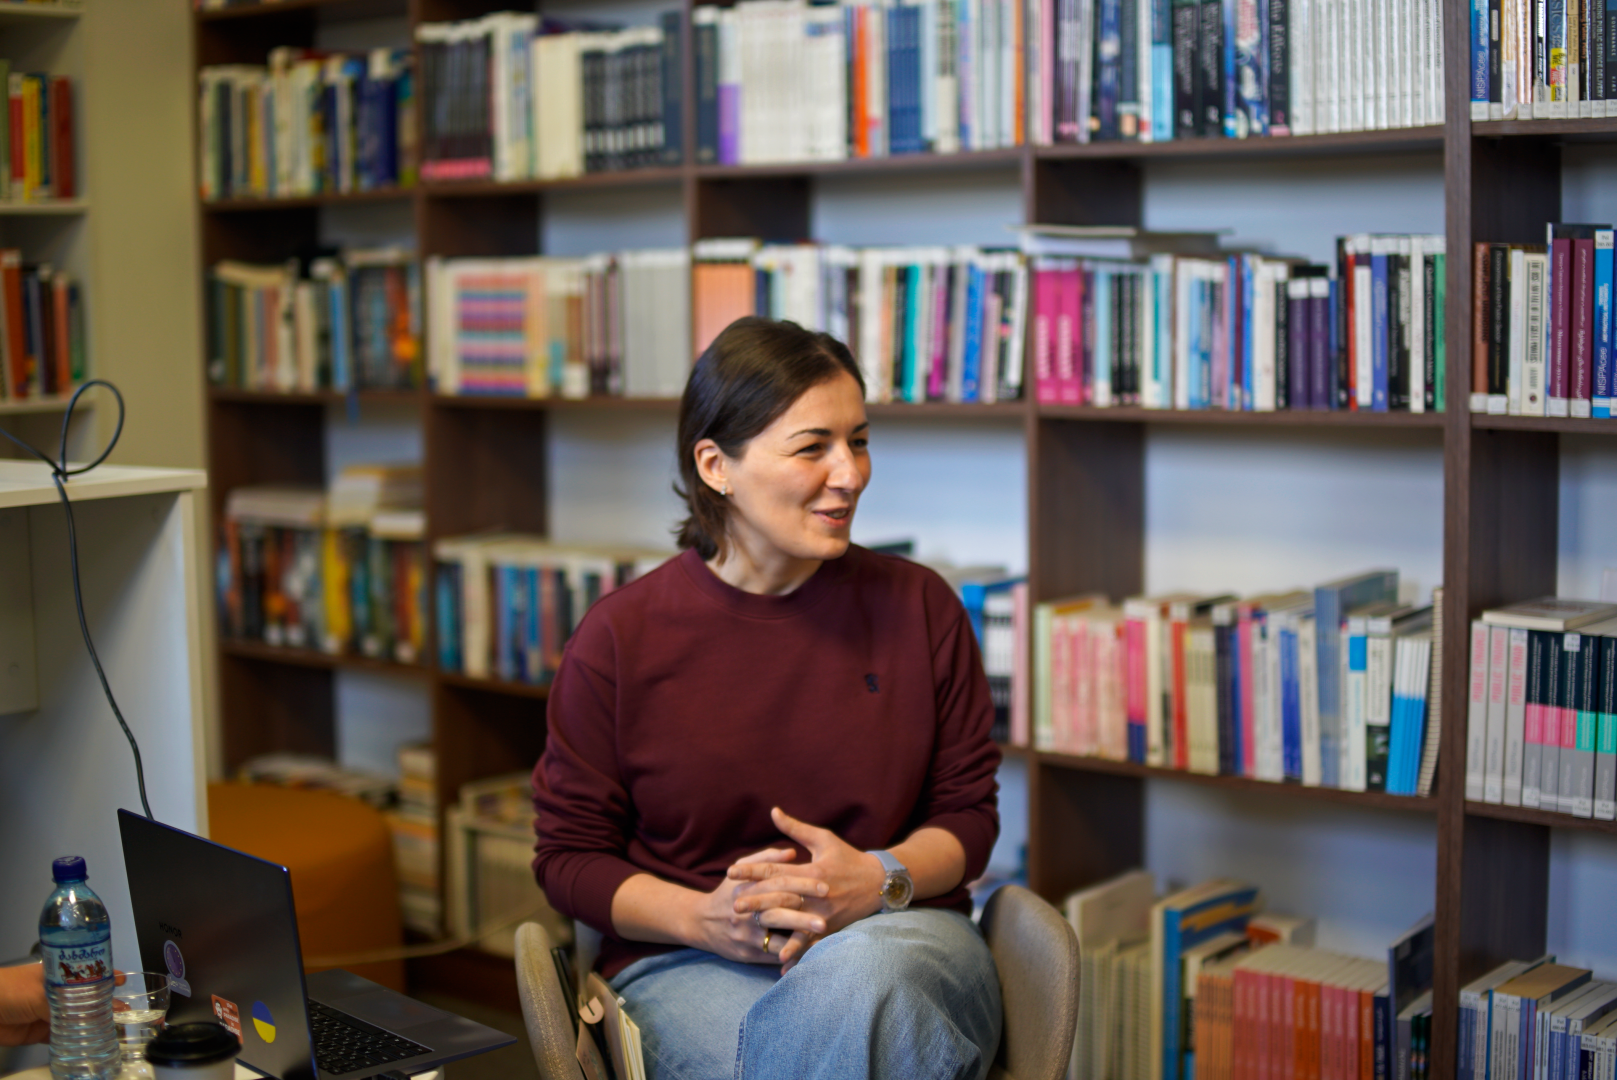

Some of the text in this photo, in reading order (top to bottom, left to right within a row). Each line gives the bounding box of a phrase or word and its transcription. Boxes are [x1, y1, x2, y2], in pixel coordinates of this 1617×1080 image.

[1596, 347, 1608, 396] NISPAcee
[1512, 645, 1523, 670] FINAN
[158, 921, 183, 939] HONOR
